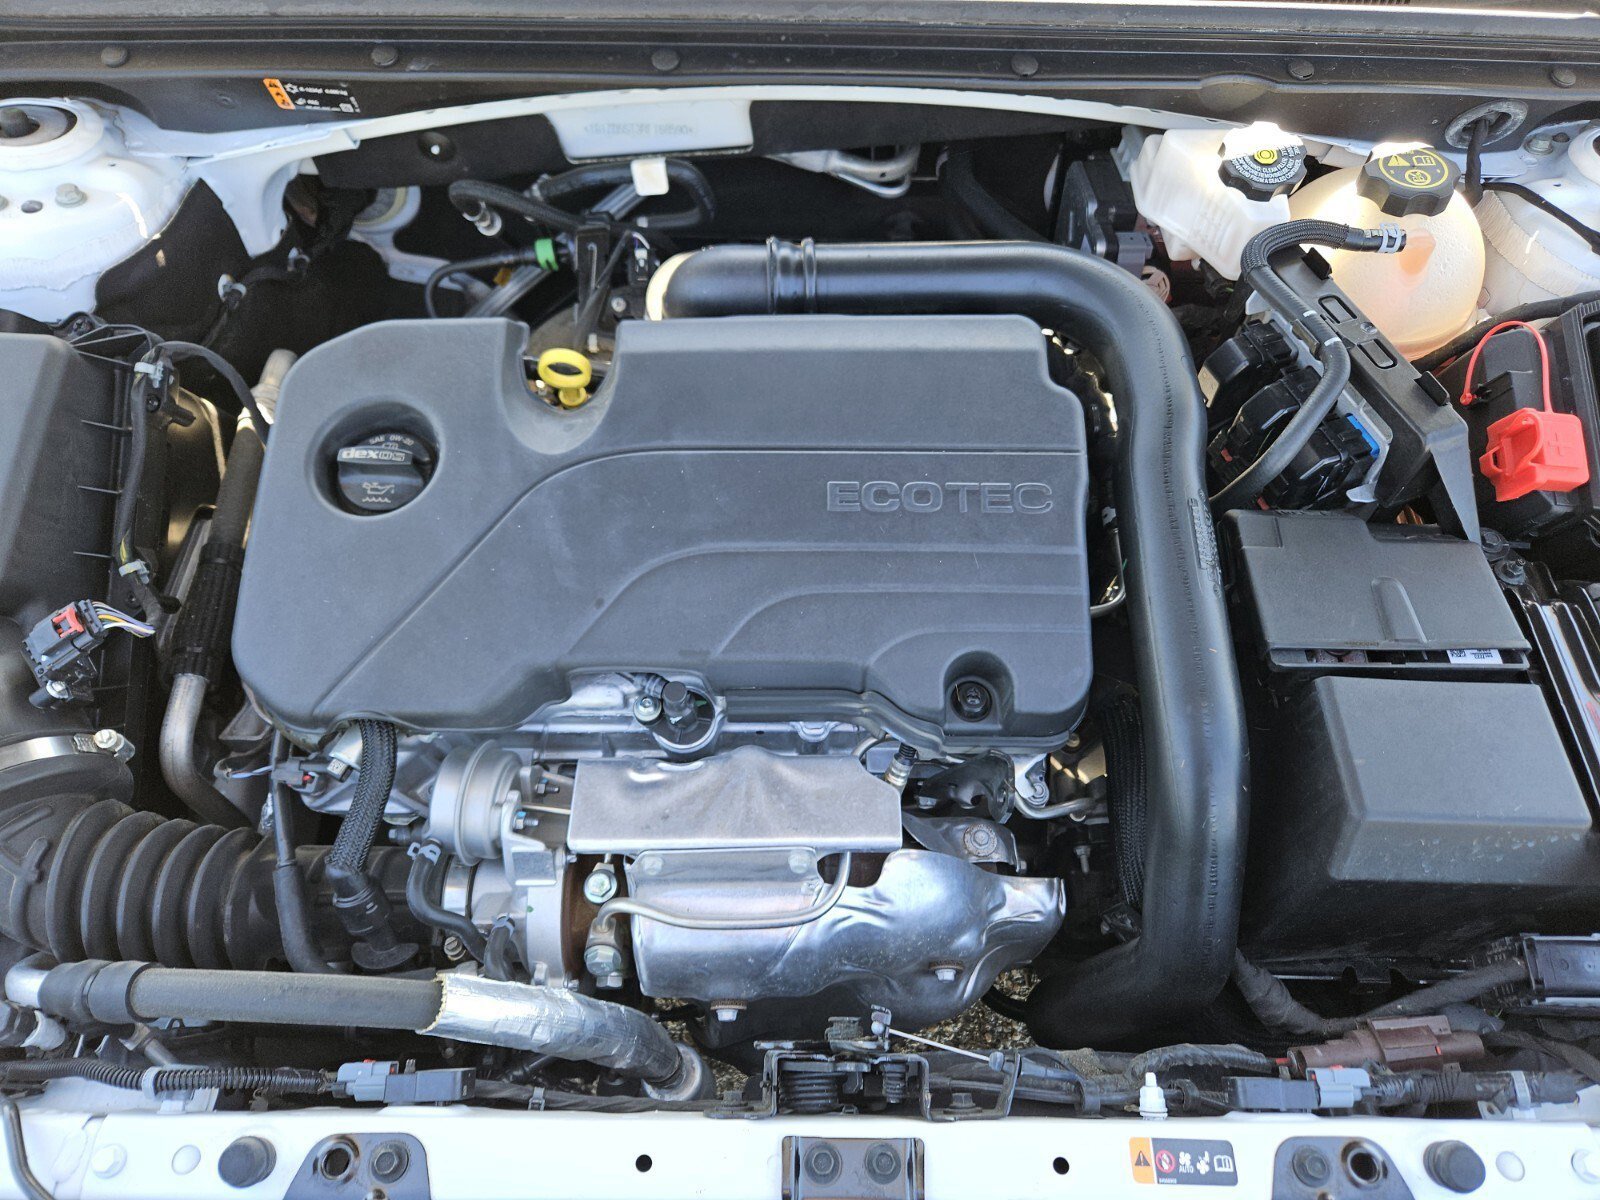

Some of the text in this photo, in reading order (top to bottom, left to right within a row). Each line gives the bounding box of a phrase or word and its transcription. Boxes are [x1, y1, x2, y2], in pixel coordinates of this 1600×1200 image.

[1249, 174, 1265, 183] FROM
[1268, 175, 1287, 184] SEALED
[1285, 159, 1302, 179] CONTAINER
[369, 435, 415, 447] SAE 0W-20
[342, 448, 405, 462] dexos
[826, 480, 1054, 515] ECOTEC
[1179, 1166, 1194, 1174] AUTO
